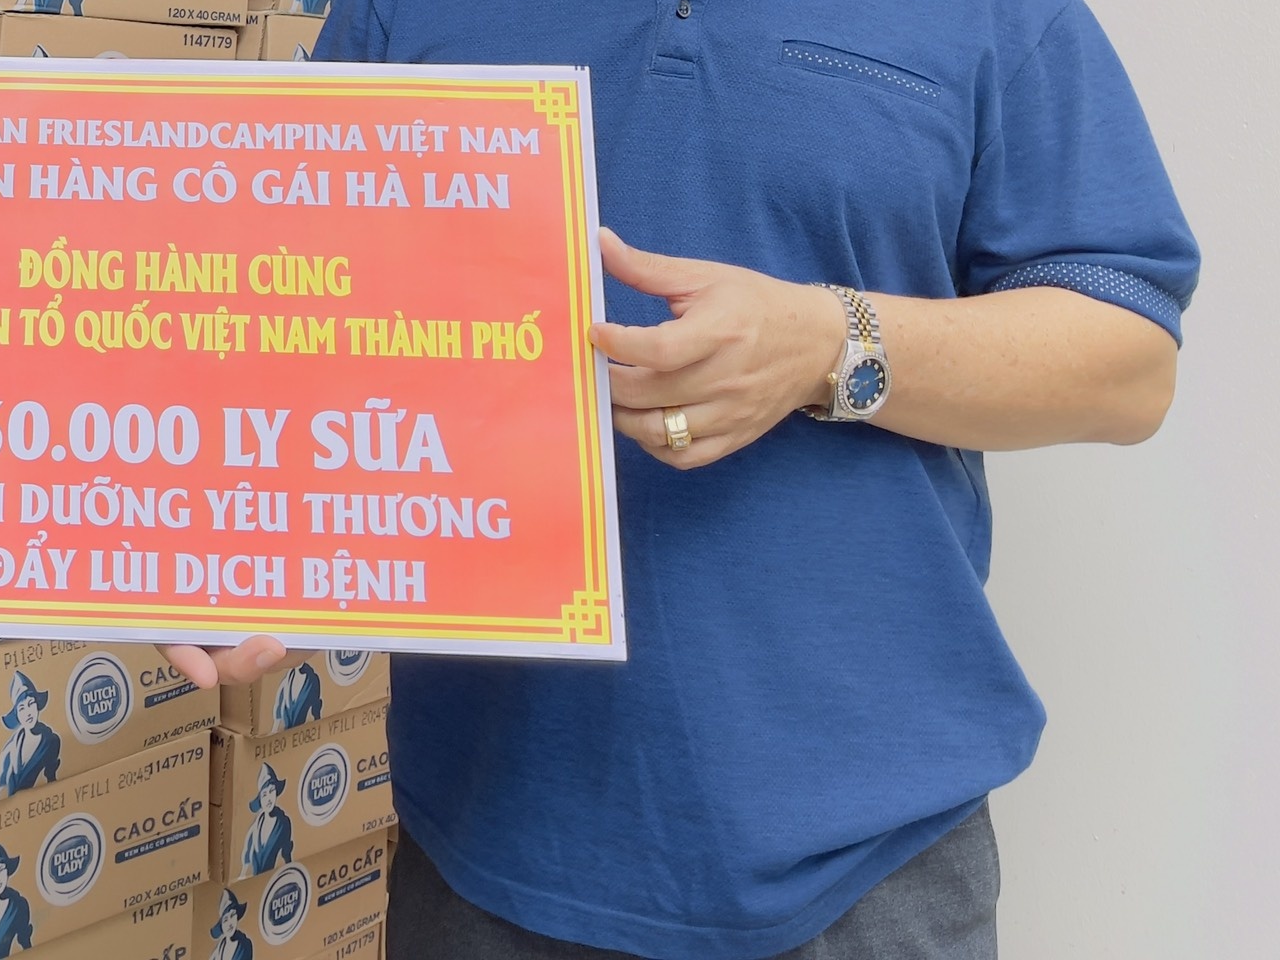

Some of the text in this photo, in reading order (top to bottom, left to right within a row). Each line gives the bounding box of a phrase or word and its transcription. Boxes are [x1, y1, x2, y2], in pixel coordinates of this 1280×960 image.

[168, 7, 186, 19] 120
[187, 9, 195, 20] X
[196, 10, 209, 21] 40
[210, 11, 241, 22] GRAM
[183, 33, 233, 49] 1147179
[38, 118, 367, 151] FRIESLANDCAMPINA
[375, 119, 449, 158] VIỆT
[459, 126, 540, 155] NAM
[29, 158, 157, 201] HÀNG
[173, 161, 237, 203] CÔ
[251, 163, 330, 206] GÁI
[345, 164, 411, 208] HÀ
[423, 172, 510, 209] LAN
[19, 236, 352, 297] ĐỒNG HÀNH CÙNG
[19, 293, 65, 347] TỔ
[74, 300, 172, 353] QUỐC
[179, 305, 251, 360] VIỆT
[259, 315, 336, 354] NAM
[344, 310, 462, 359] THÀNH
[471, 310, 544, 361] PHỐ
[222, 407, 292, 468] LY
[310, 397, 453, 473] SỮA
[20, 476, 191, 528] DƯỠNG
[203, 481, 289, 532] YÊU
[302, 493, 511, 540] THƯƠNG
[89, 541, 159, 593] LÙI
[174, 552, 286, 605] DỊCH
[302, 549, 427, 610] BỆNH
[4, 644, 43, 669] P1120
[82, 685, 116, 705] DUTCH
[87, 700, 114, 717] LADY
[143, 716, 216, 747] 120 X 40 GRAM
[149, 746, 204, 775] 1147179
[311, 771, 338, 790] DUTCH
[313, 783, 337, 799] LADY
[28, 792, 65, 820] E0821
[113, 797, 203, 843] CAO CẤP
[362, 818, 377, 832] 120
[53, 844, 89, 867] DUTCH
[57, 857, 86, 877] LADY
[317, 845, 383, 888] CAO CẤP
[124, 872, 201, 909] 120 X 40 GRAM
[272, 889, 298, 910] DUTCH
[132, 892, 188, 924] 1147179
[274, 904, 295, 920] LADY
[323, 932, 338, 946] 120
[346, 923, 356, 934] 40
[356, 911, 380, 929] GRAM
[336, 930, 375, 960] 1147179
